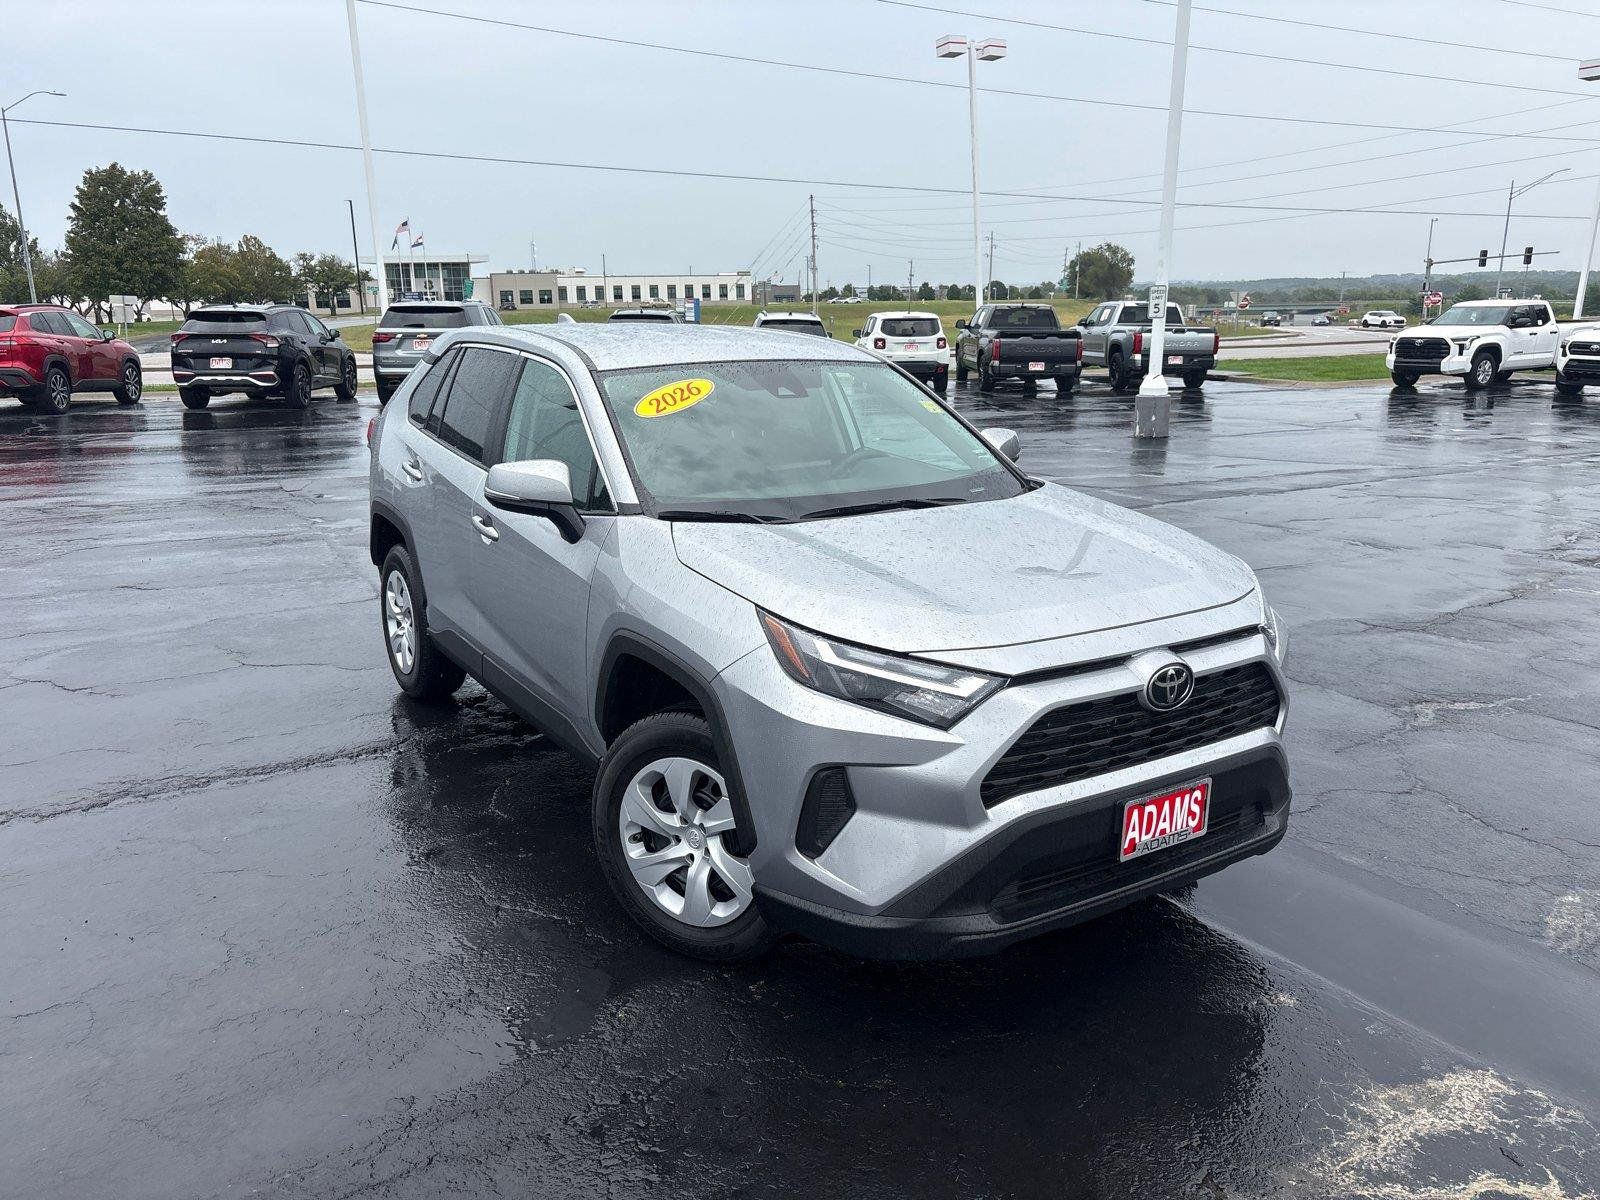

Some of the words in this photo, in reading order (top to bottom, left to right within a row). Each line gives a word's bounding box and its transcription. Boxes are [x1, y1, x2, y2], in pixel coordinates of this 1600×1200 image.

[1153, 304, 1160, 314] 5
[648, 381, 702, 414] 2026
[1123, 789, 1202, 849] ADAMS
